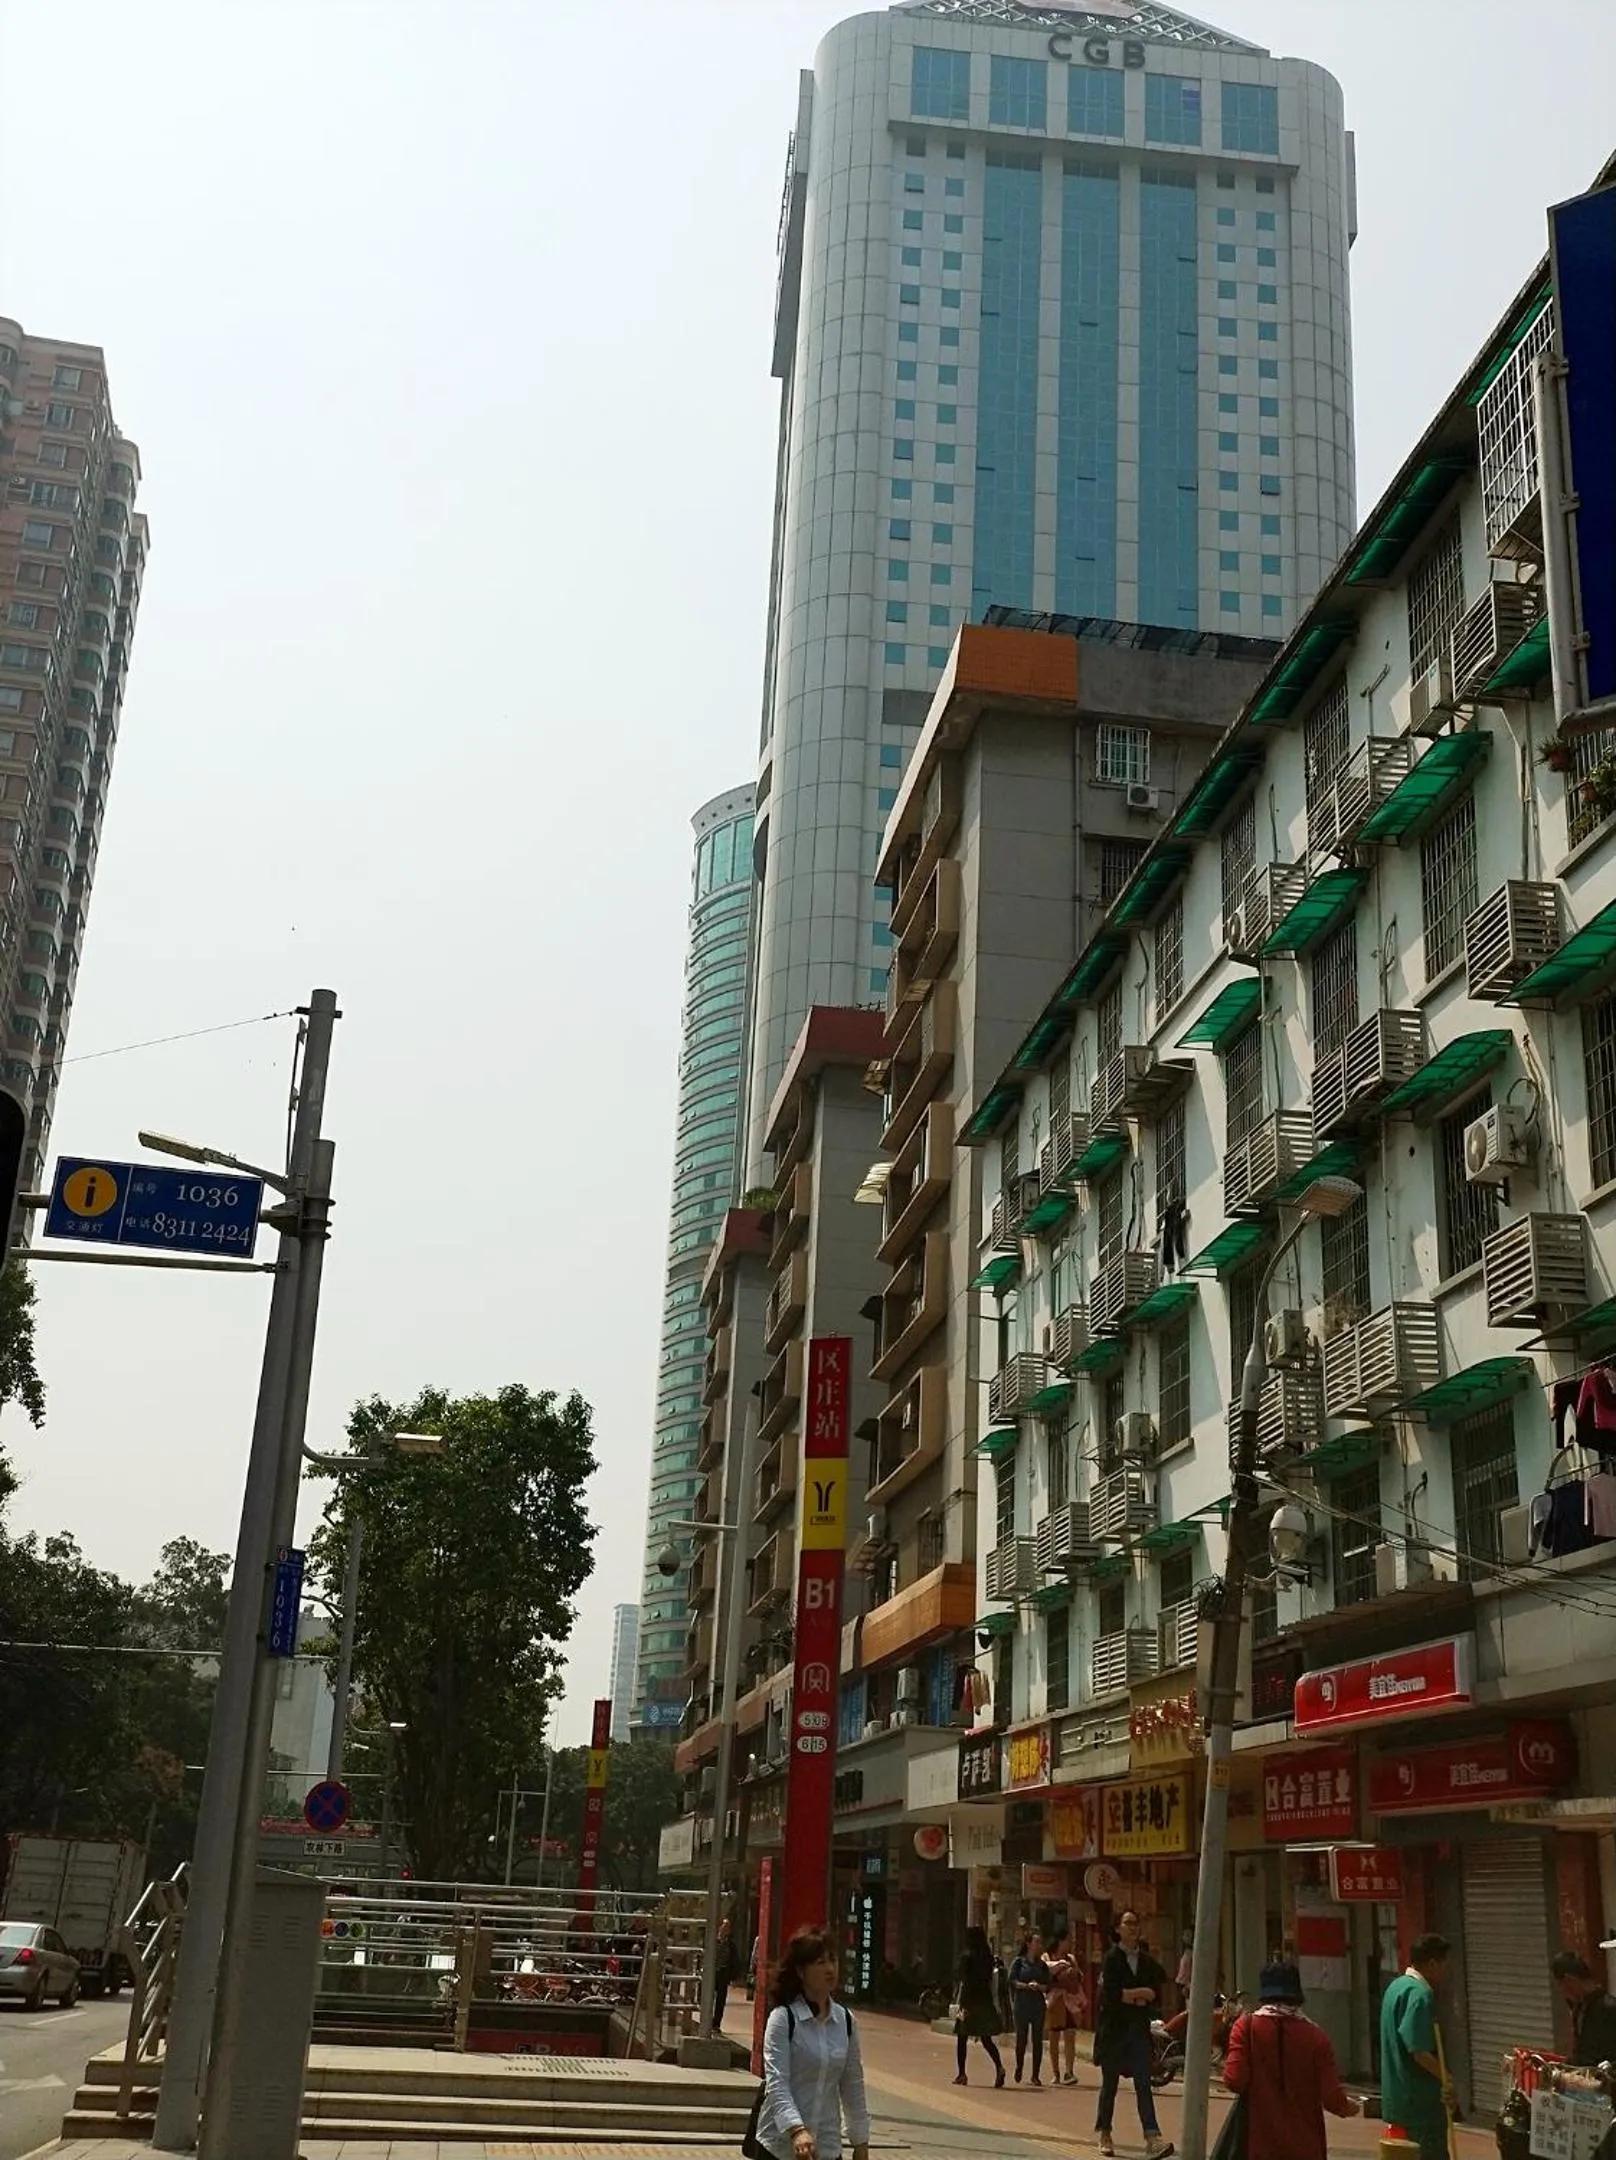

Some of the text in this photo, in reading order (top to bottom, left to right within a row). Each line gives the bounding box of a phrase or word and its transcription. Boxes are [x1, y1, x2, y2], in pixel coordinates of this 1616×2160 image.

[1048, 33, 1146, 68] CGB
[176, 1184, 240, 1209] 1036
[200, 1223, 250, 1247] 2424
[814, 1346, 841, 1440] 区庄站
[805, 1577, 835, 1610] B1
[1281, 1769, 1351, 1809] 合富置业
